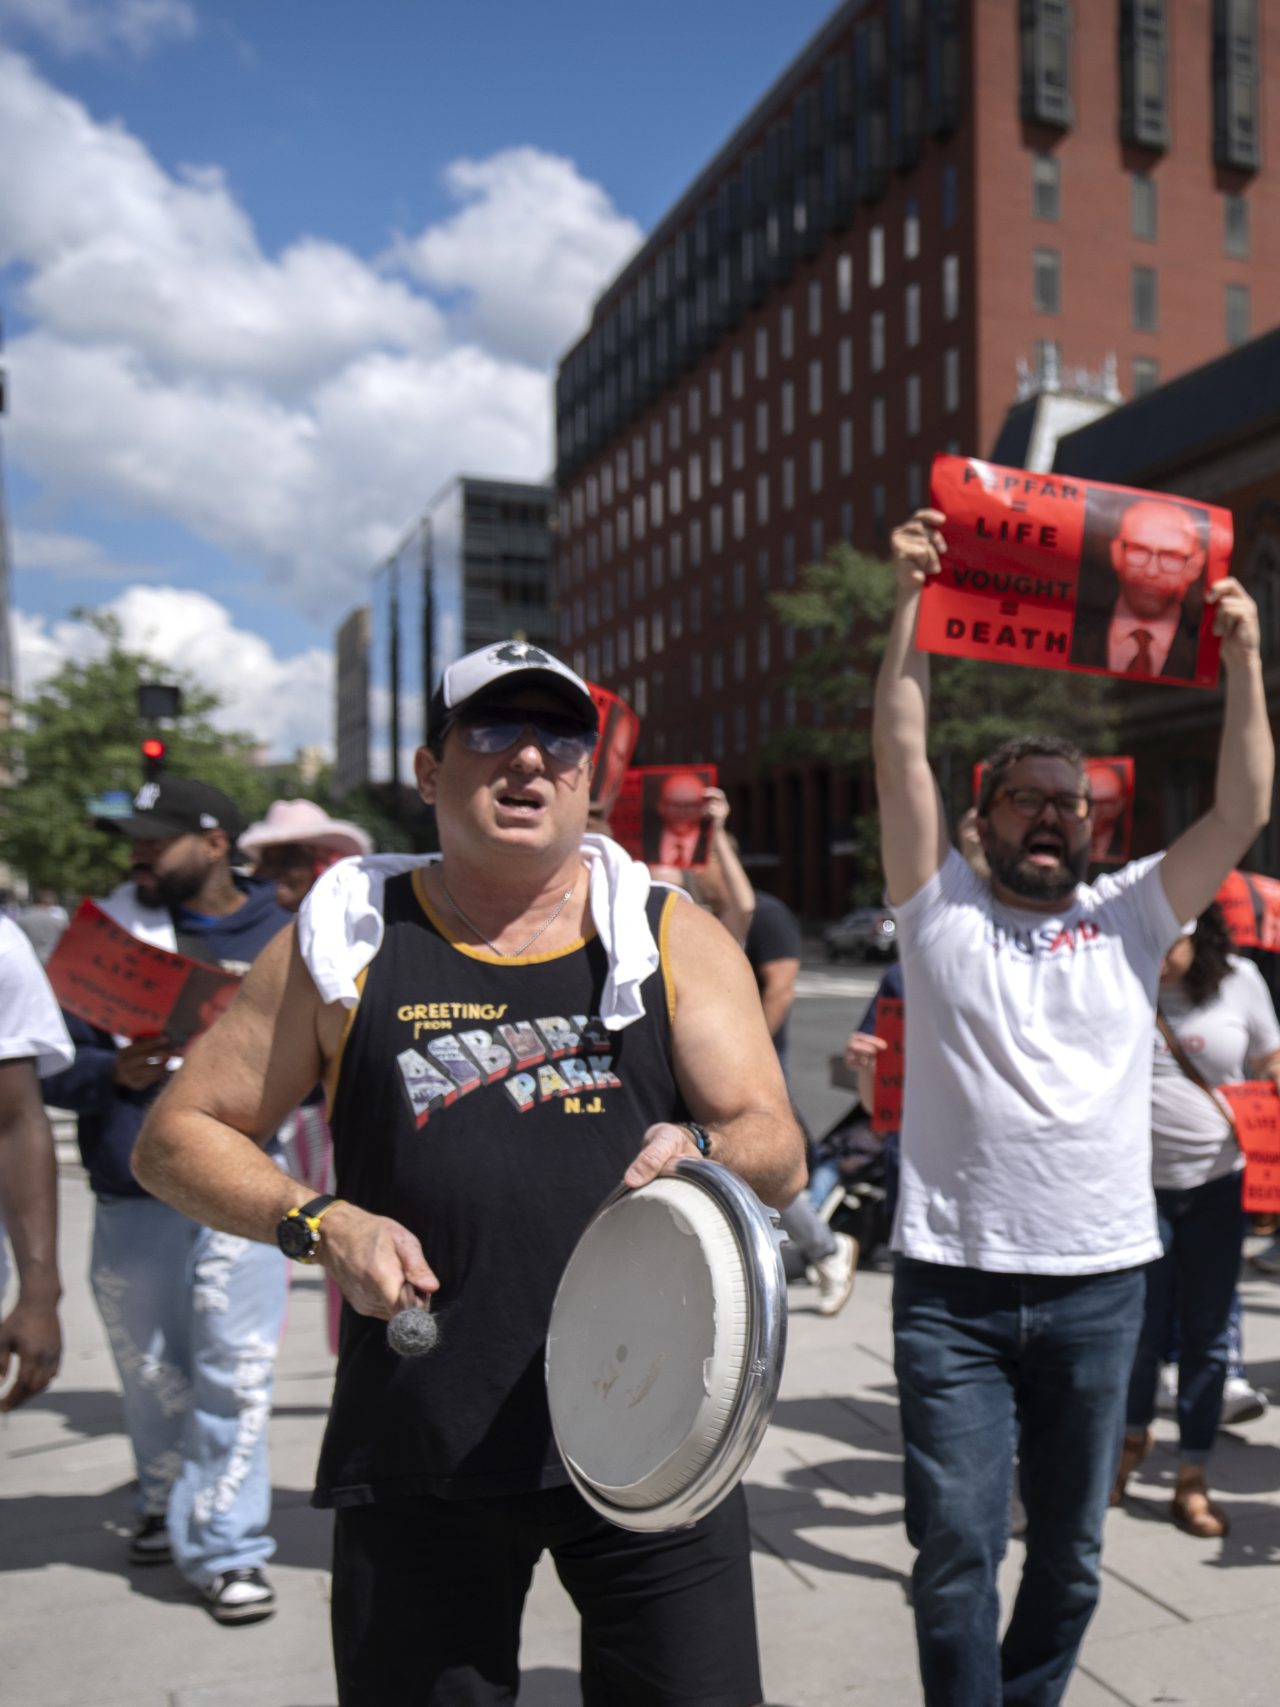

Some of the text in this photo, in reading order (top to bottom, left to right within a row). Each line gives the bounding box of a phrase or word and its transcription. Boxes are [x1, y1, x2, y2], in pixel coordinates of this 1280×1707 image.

[963, 468, 1080, 499] PEPFAR
[975, 517, 1058, 548] LIFE
[953, 567, 1073, 599] VOUGHT
[945, 617, 1068, 654] DEATH
[397, 1002, 508, 1022] GREETINGS
[413, 1020, 453, 1040] FROM
[396, 1014, 611, 1131] ASBURY
[503, 1055, 622, 1113] PARK
[564, 1096, 606, 1114] N.J.
